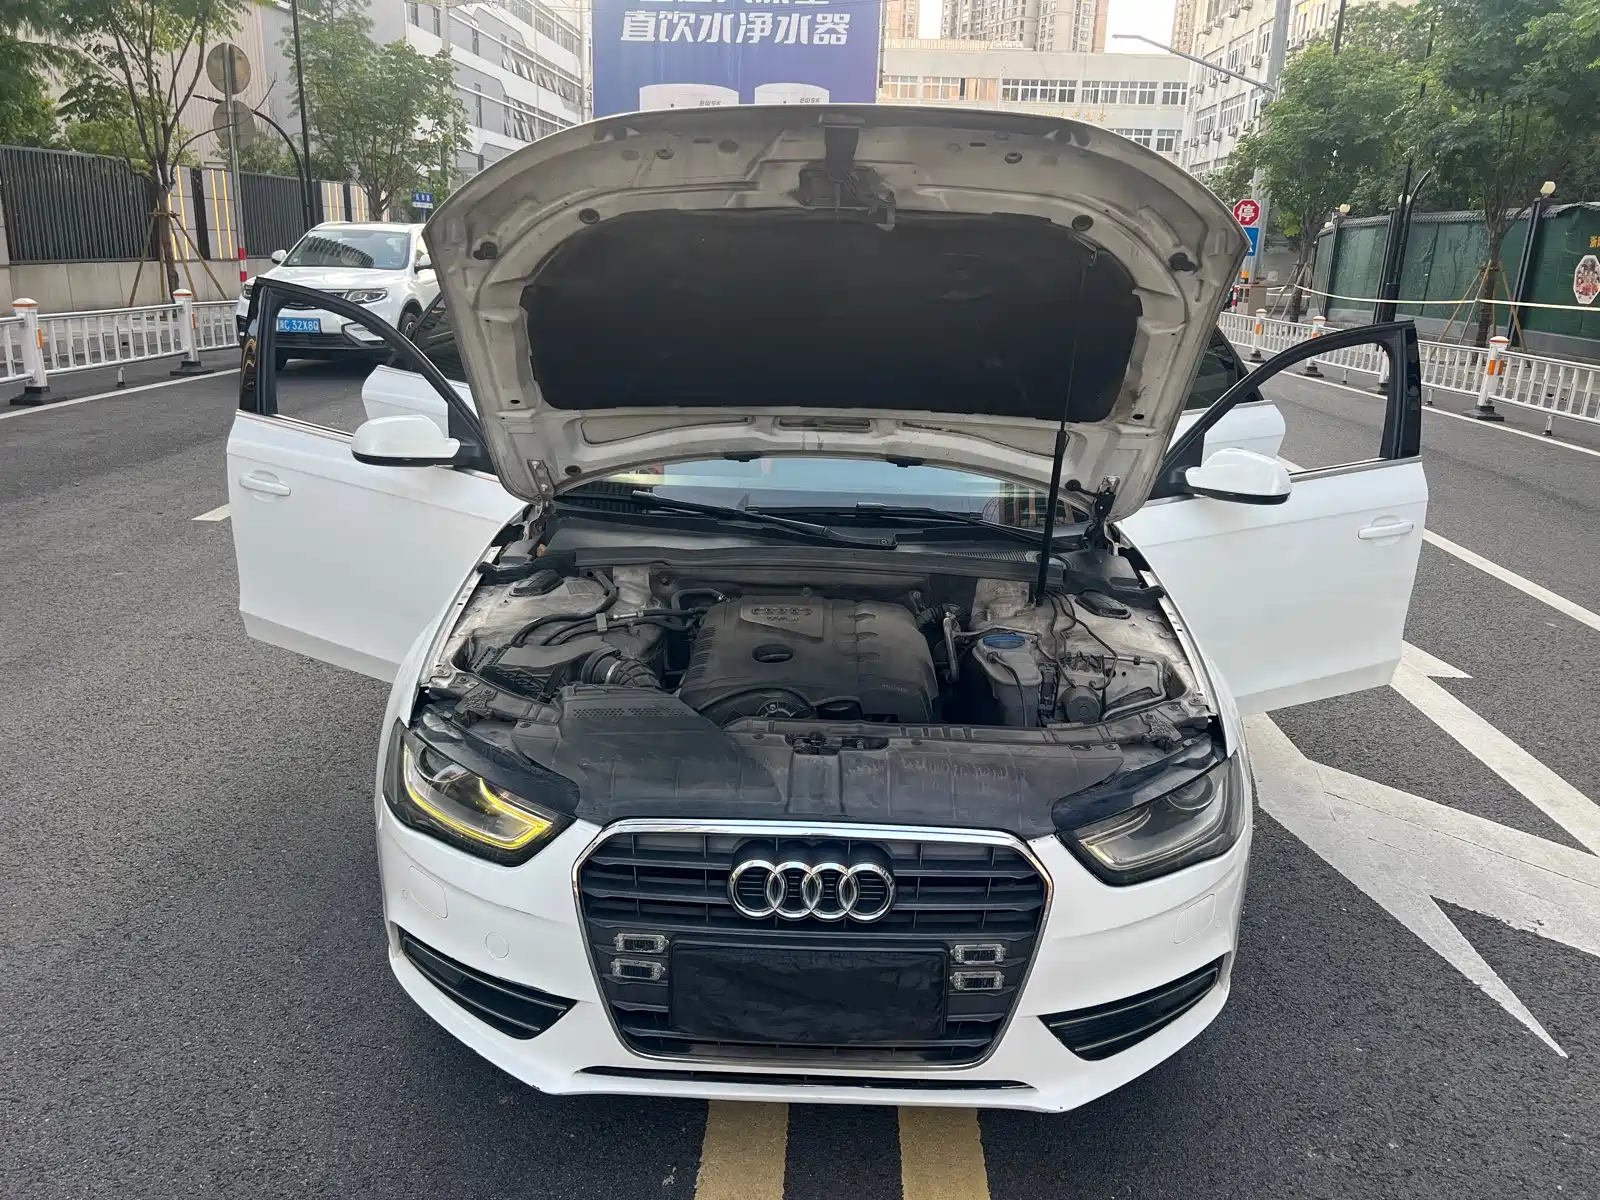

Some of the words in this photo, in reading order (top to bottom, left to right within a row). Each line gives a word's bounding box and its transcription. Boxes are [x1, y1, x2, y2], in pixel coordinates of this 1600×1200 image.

[620, 11, 851, 45] 直饮水净水器
[1237, 203, 1256, 222] 停
